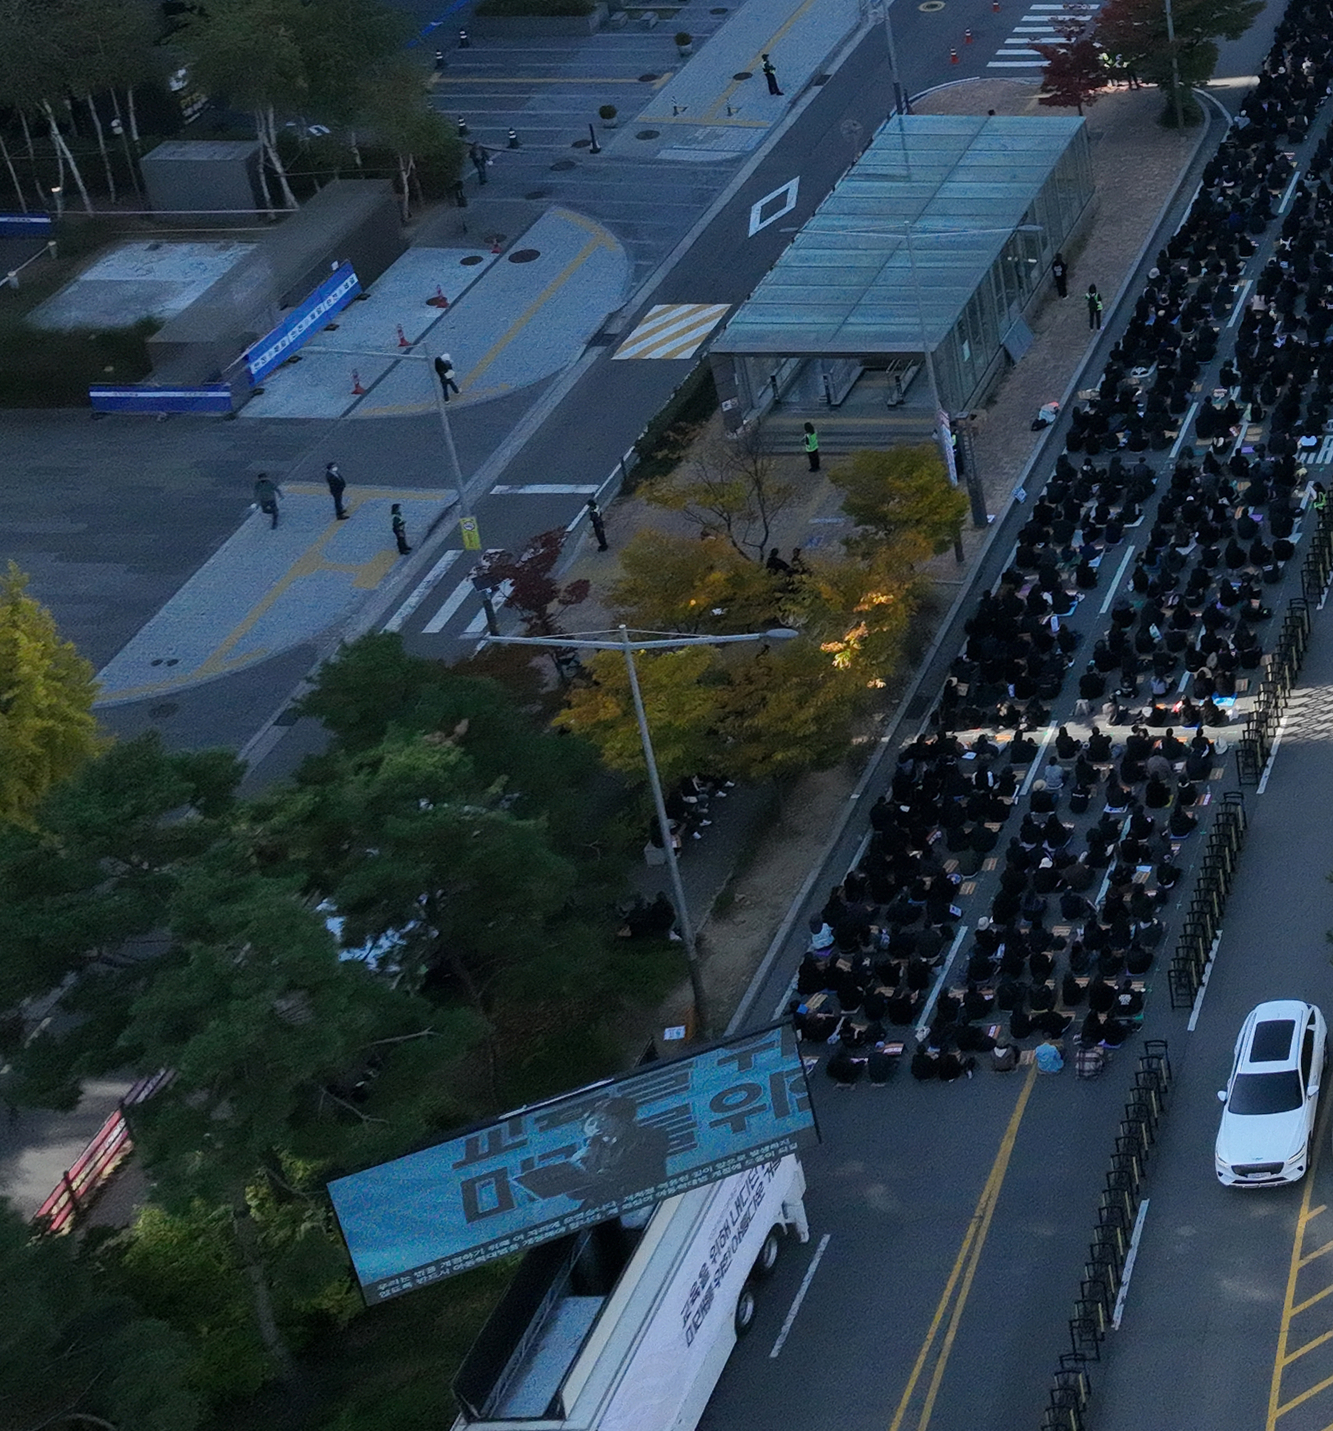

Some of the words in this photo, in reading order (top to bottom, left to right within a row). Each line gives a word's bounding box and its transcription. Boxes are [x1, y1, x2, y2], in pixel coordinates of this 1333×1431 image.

[731, 1183, 766, 1250] 아름다운
[680, 1262, 710, 1329] 교육을
[709, 1218, 732, 1265] 위해
